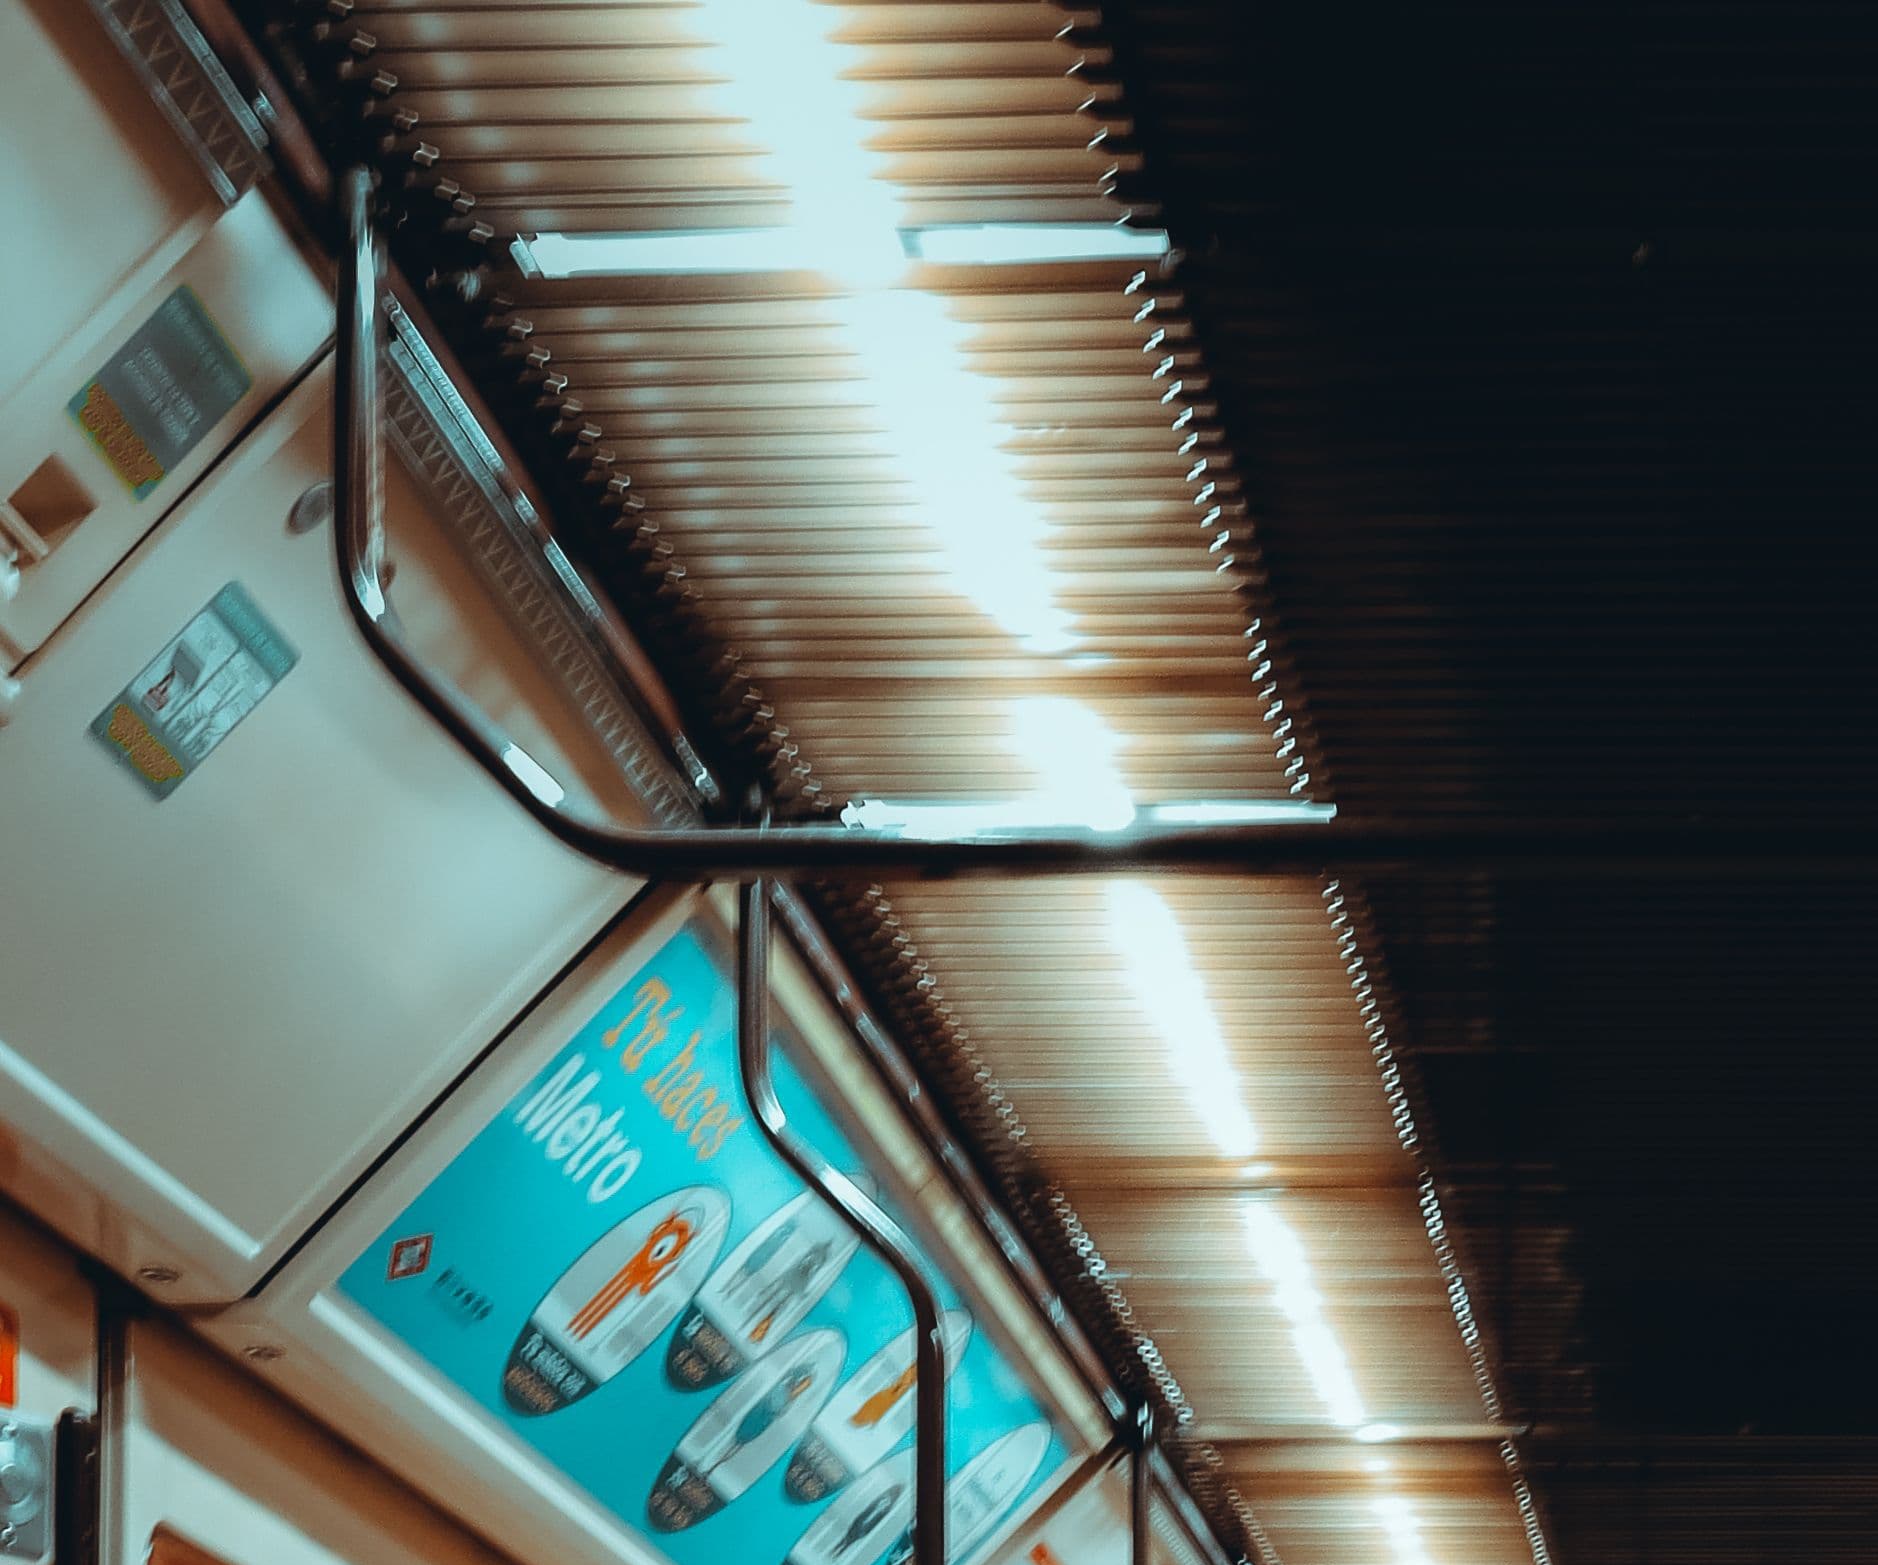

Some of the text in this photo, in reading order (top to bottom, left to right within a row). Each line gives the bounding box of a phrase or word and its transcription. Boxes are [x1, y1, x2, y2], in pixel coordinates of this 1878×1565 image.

[512, 1053, 643, 1203] Metro
[601, 975, 746, 1161] Tú haces
